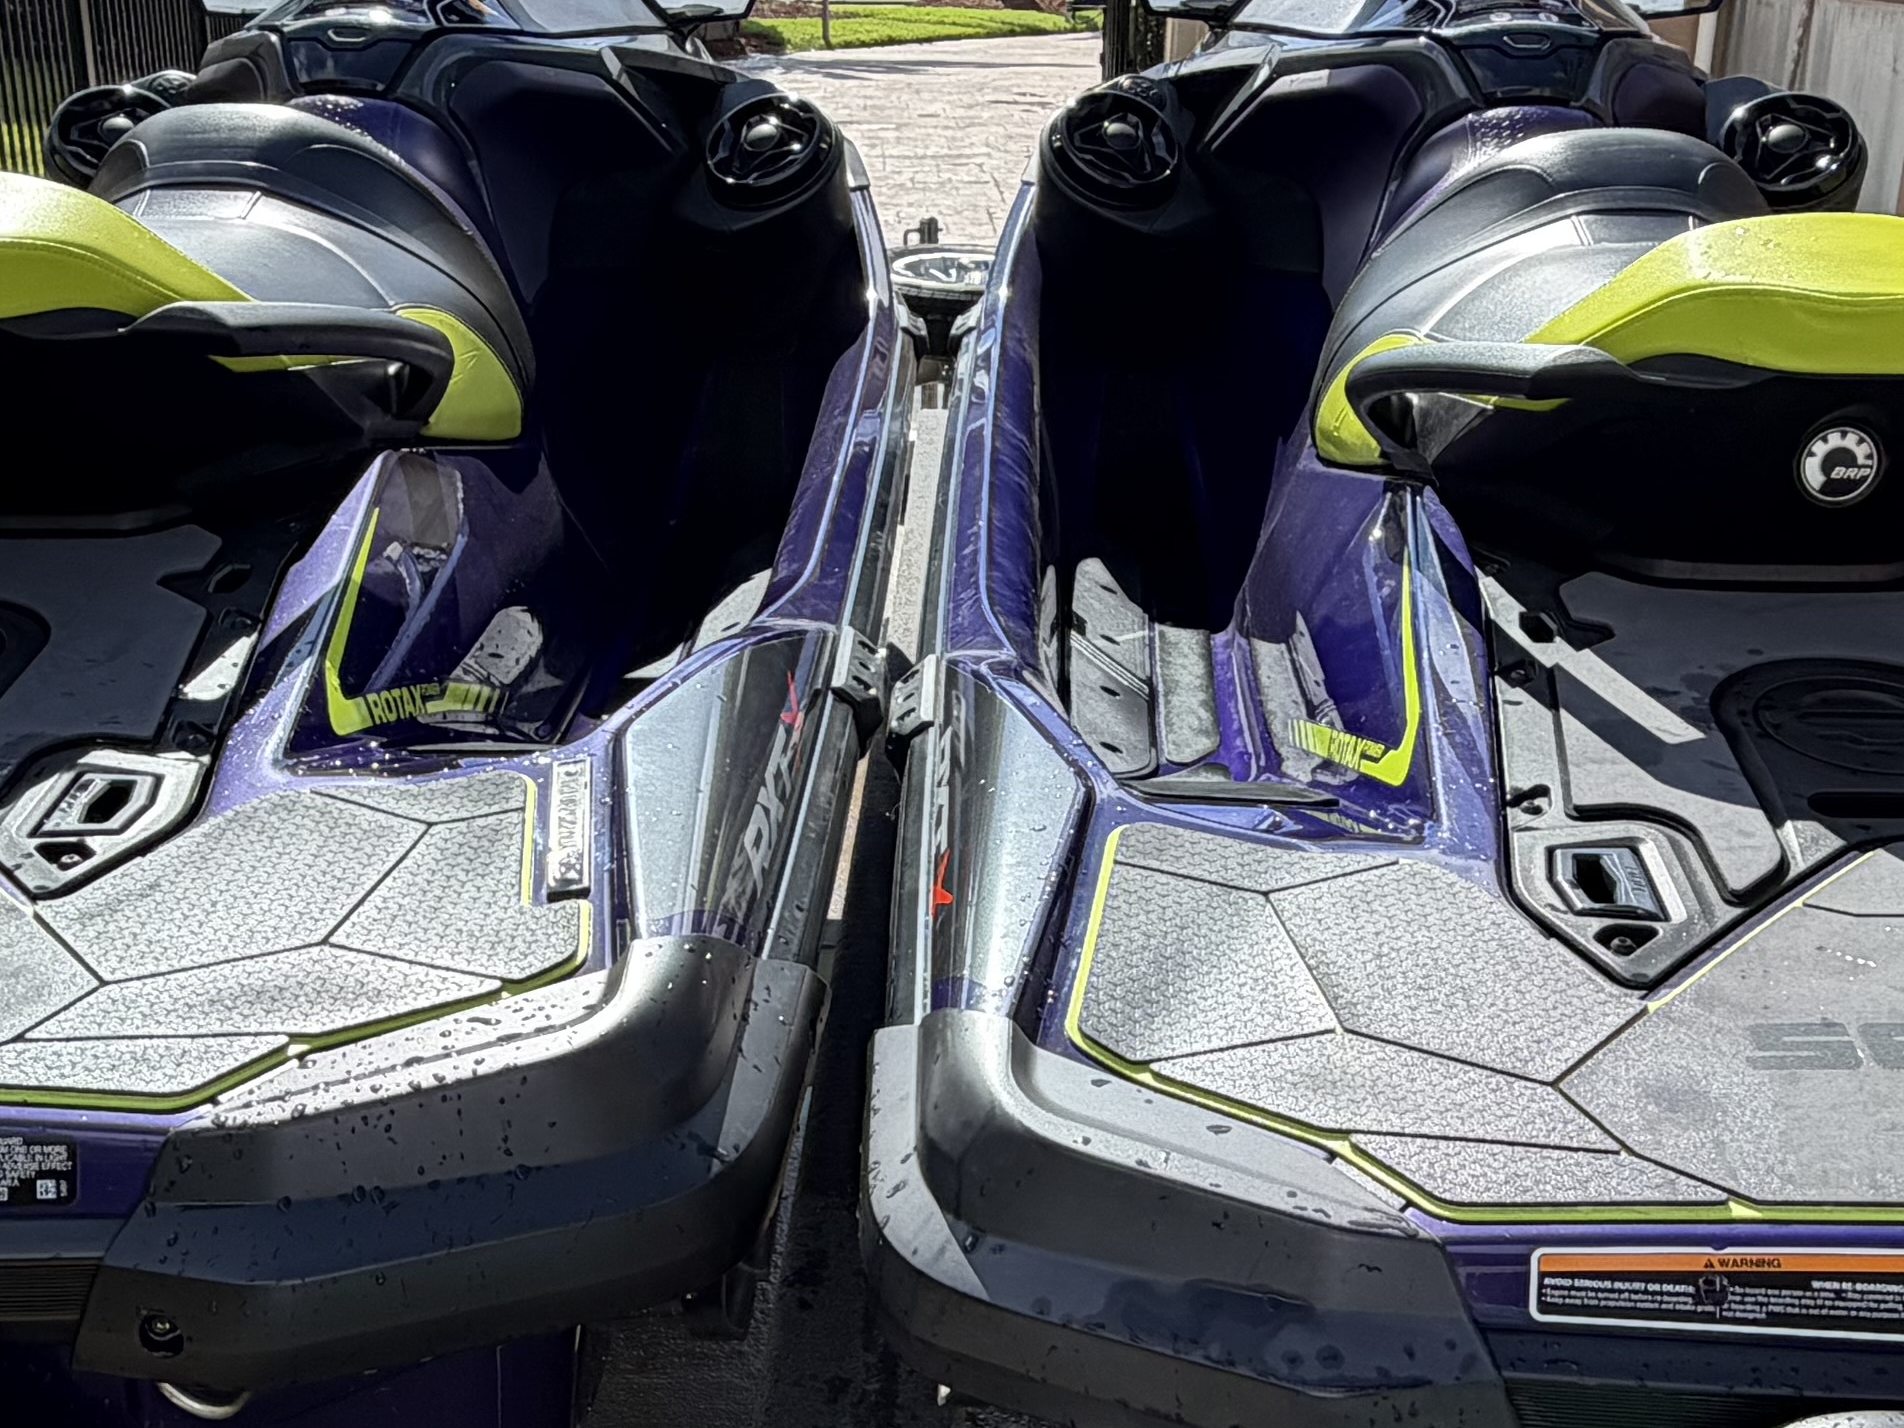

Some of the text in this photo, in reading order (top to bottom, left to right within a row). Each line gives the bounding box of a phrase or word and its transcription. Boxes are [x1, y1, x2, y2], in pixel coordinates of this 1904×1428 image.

[1830, 466, 1871, 480] BRP
[366, 684, 425, 725] ROTAX
[1717, 1257, 1782, 1269] WARNING
